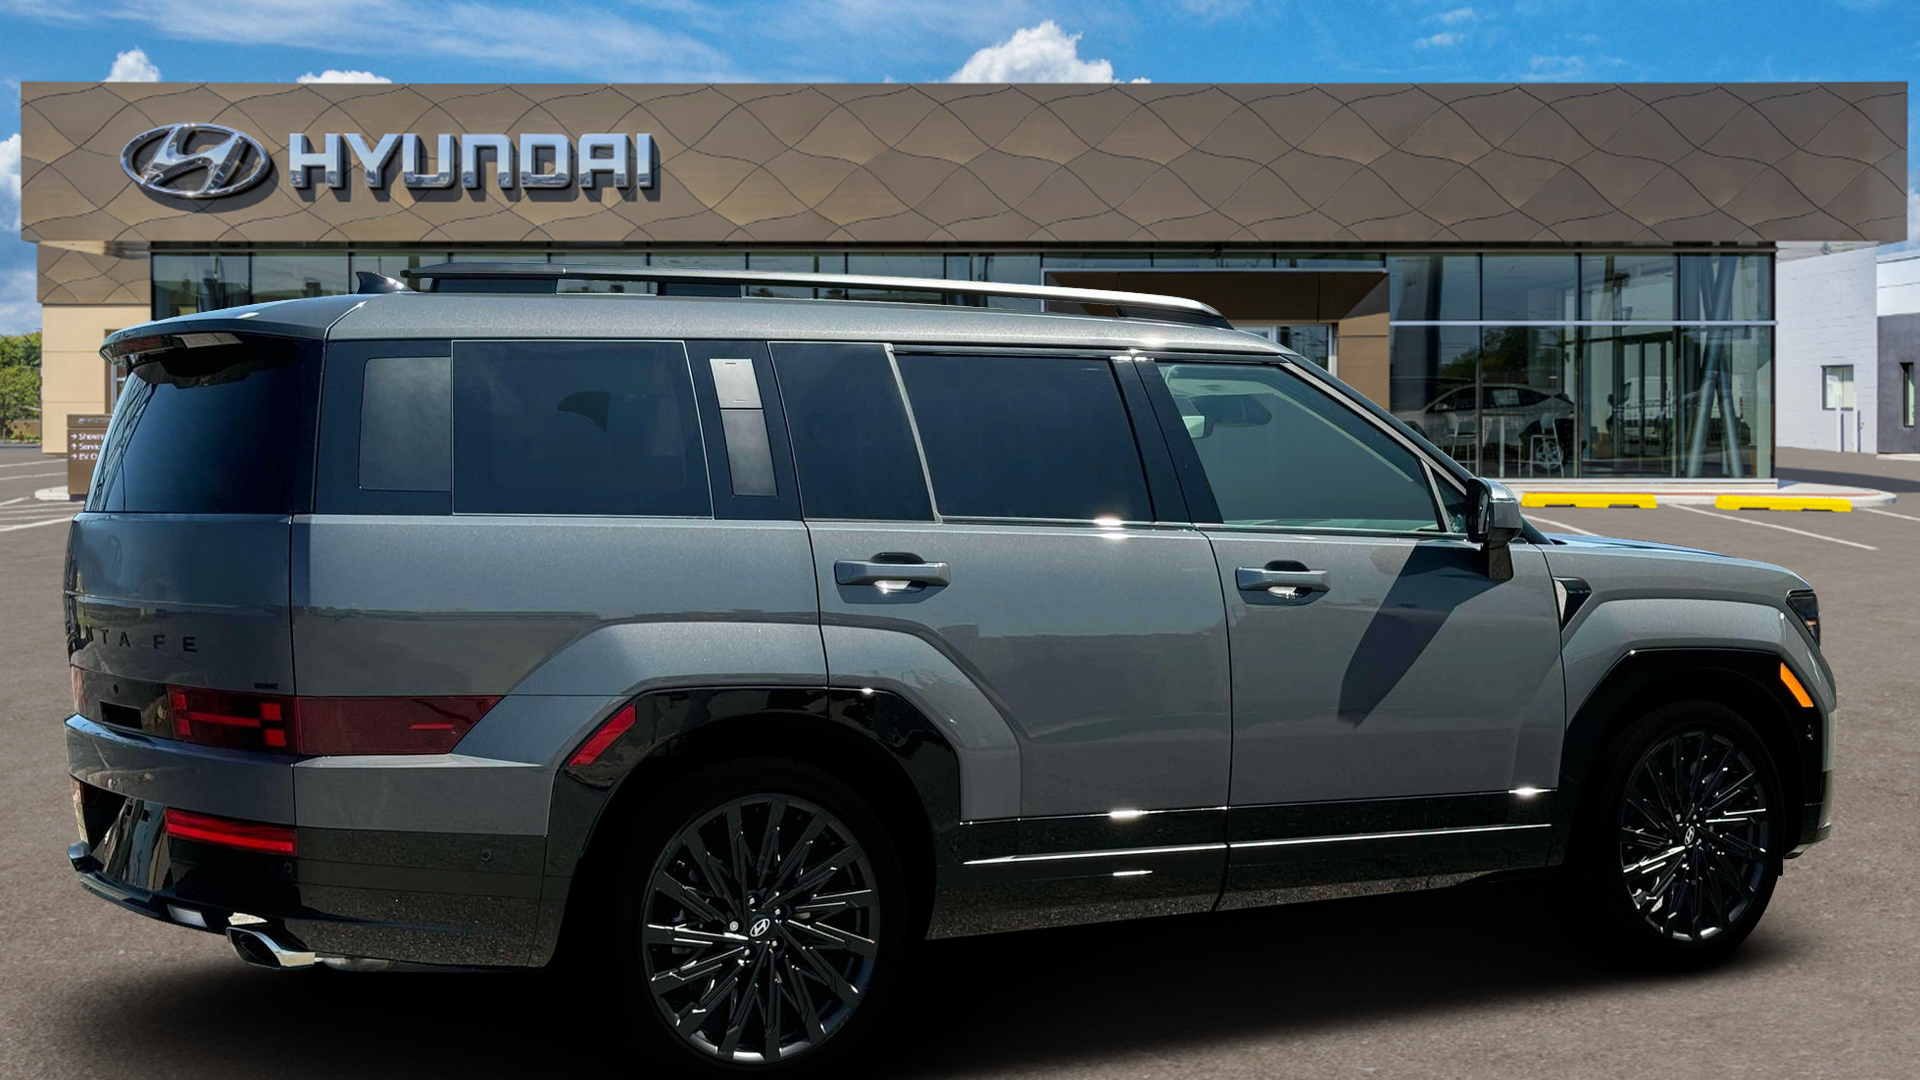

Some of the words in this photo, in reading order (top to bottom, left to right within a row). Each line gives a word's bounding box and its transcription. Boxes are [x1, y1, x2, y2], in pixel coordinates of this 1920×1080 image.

[289, 133, 654, 189] HYUNDAI
[79, 442, 101, 451] Servic
[79, 452, 89, 460] EV
[84, 625, 132, 648] NTA
[153, 634, 198, 653] FE
